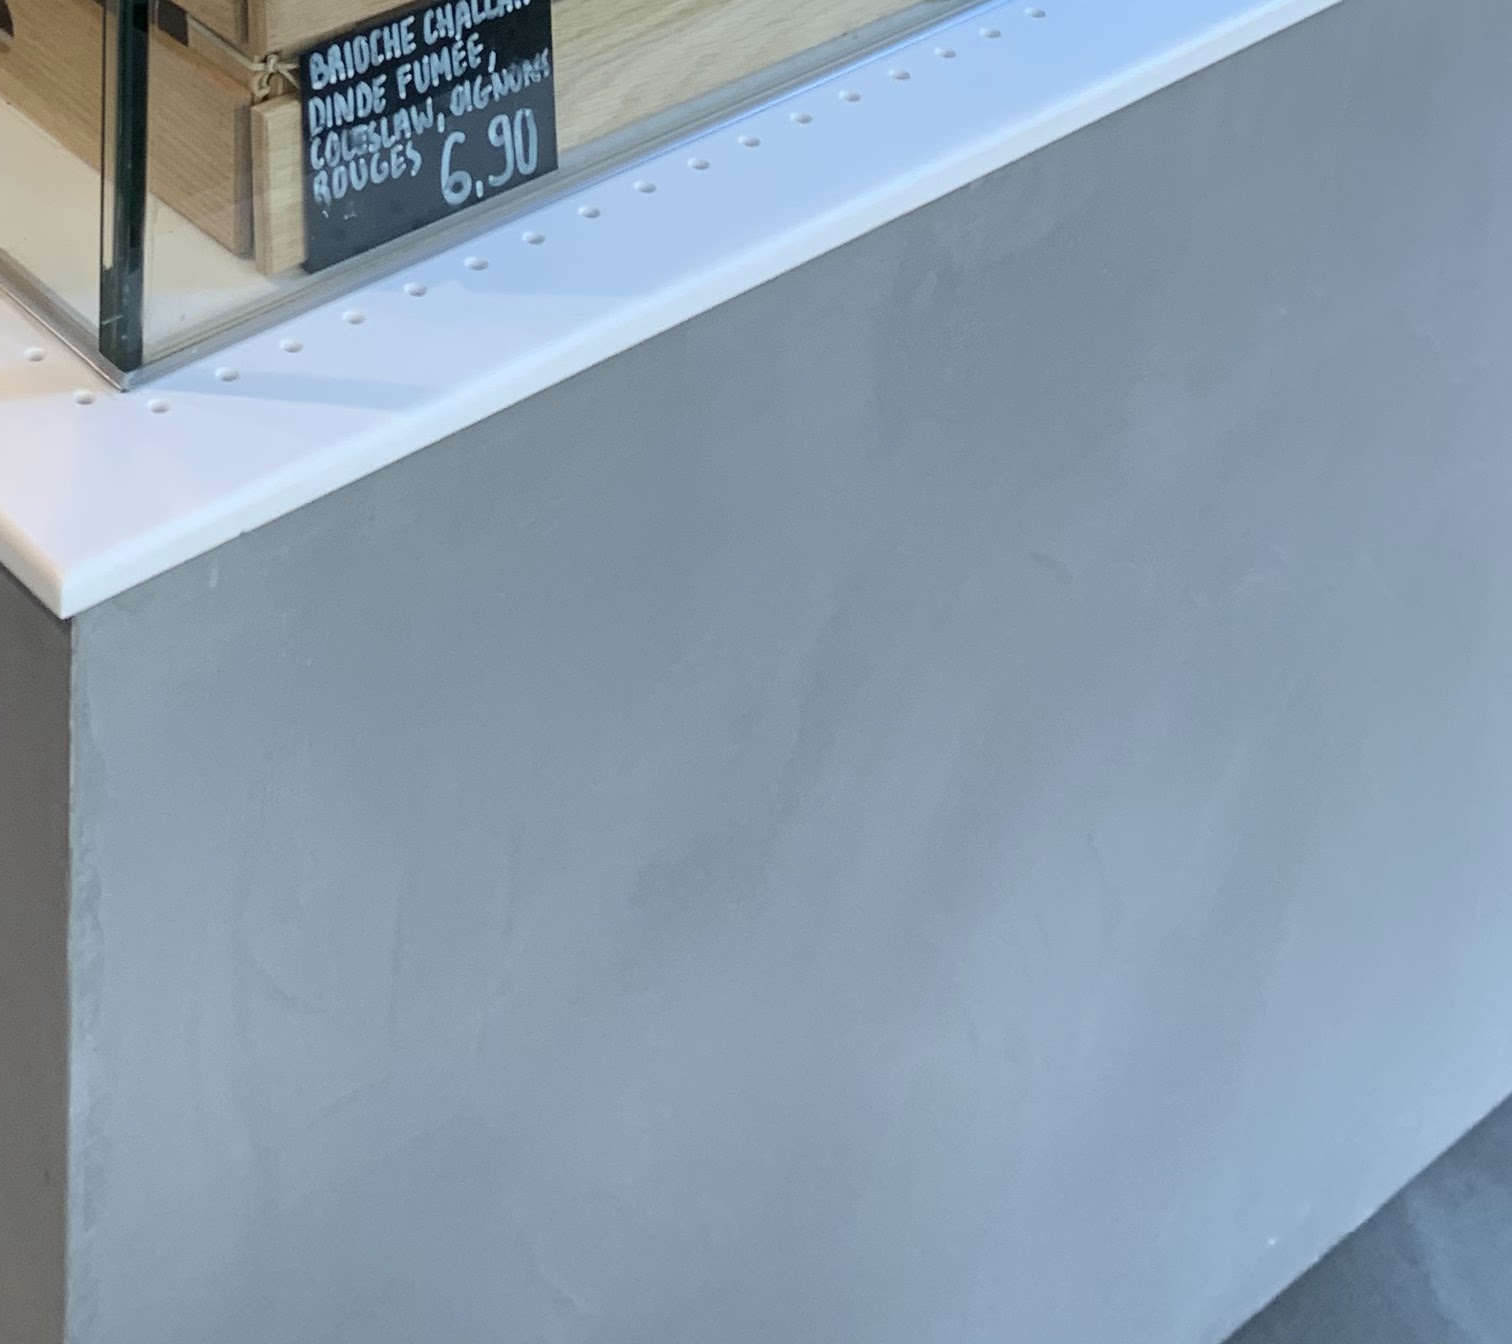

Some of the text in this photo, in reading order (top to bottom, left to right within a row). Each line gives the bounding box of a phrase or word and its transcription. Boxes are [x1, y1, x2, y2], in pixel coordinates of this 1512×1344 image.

[308, 15, 417, 91] BRIOCHE
[308, 73, 387, 137] DINDE
[313, 140, 423, 207] ROUGES
[440, 107, 538, 206] 6,90
